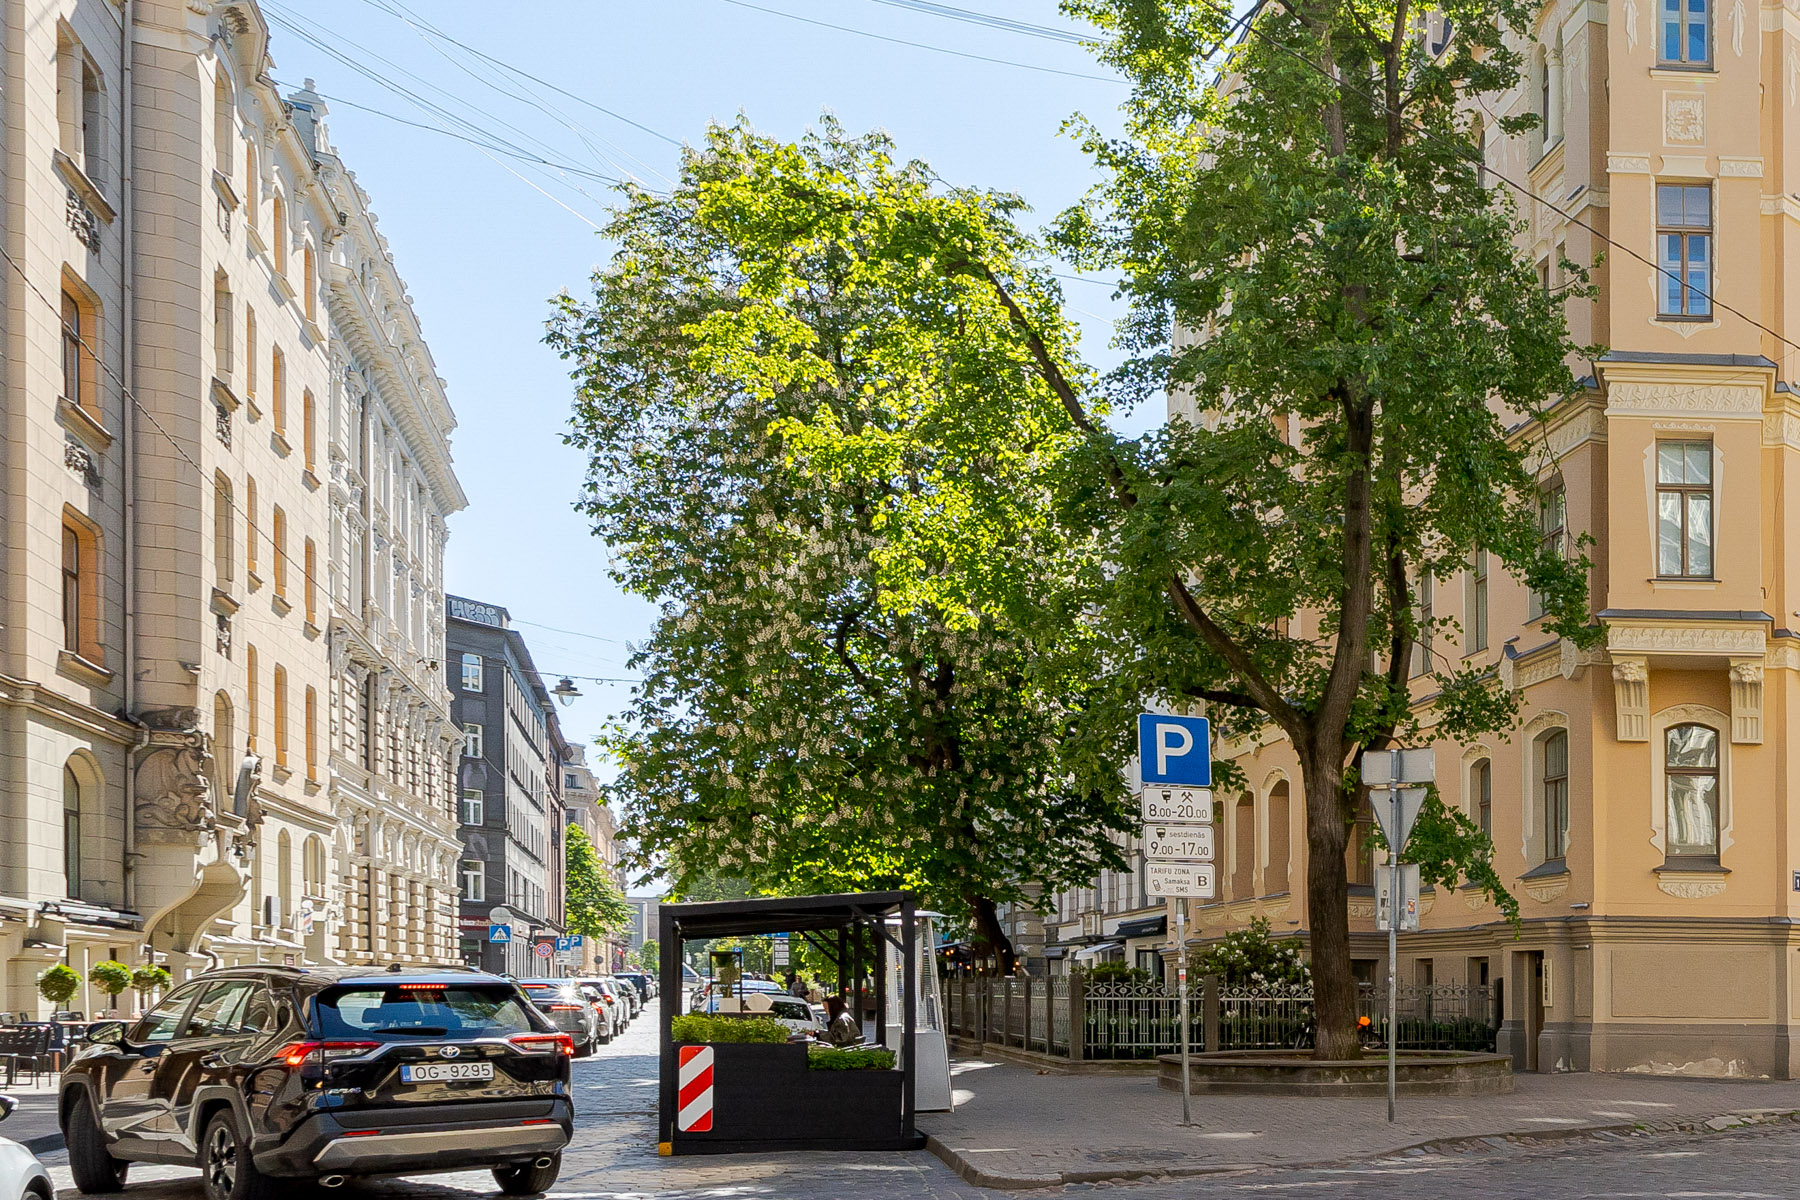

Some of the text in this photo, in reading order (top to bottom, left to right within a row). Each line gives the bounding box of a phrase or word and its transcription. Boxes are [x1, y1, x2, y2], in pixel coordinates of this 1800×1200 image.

[1156, 723, 1194, 776] P
[1148, 803, 1208, 818] 8.00-20.00
[1150, 841, 1209, 856] 9.00-17.00
[1197, 875, 1208, 887] B
[558, 939, 568, 950] P
[571, 936, 580, 946] P
[415, 1064, 491, 1079] OG-9295
